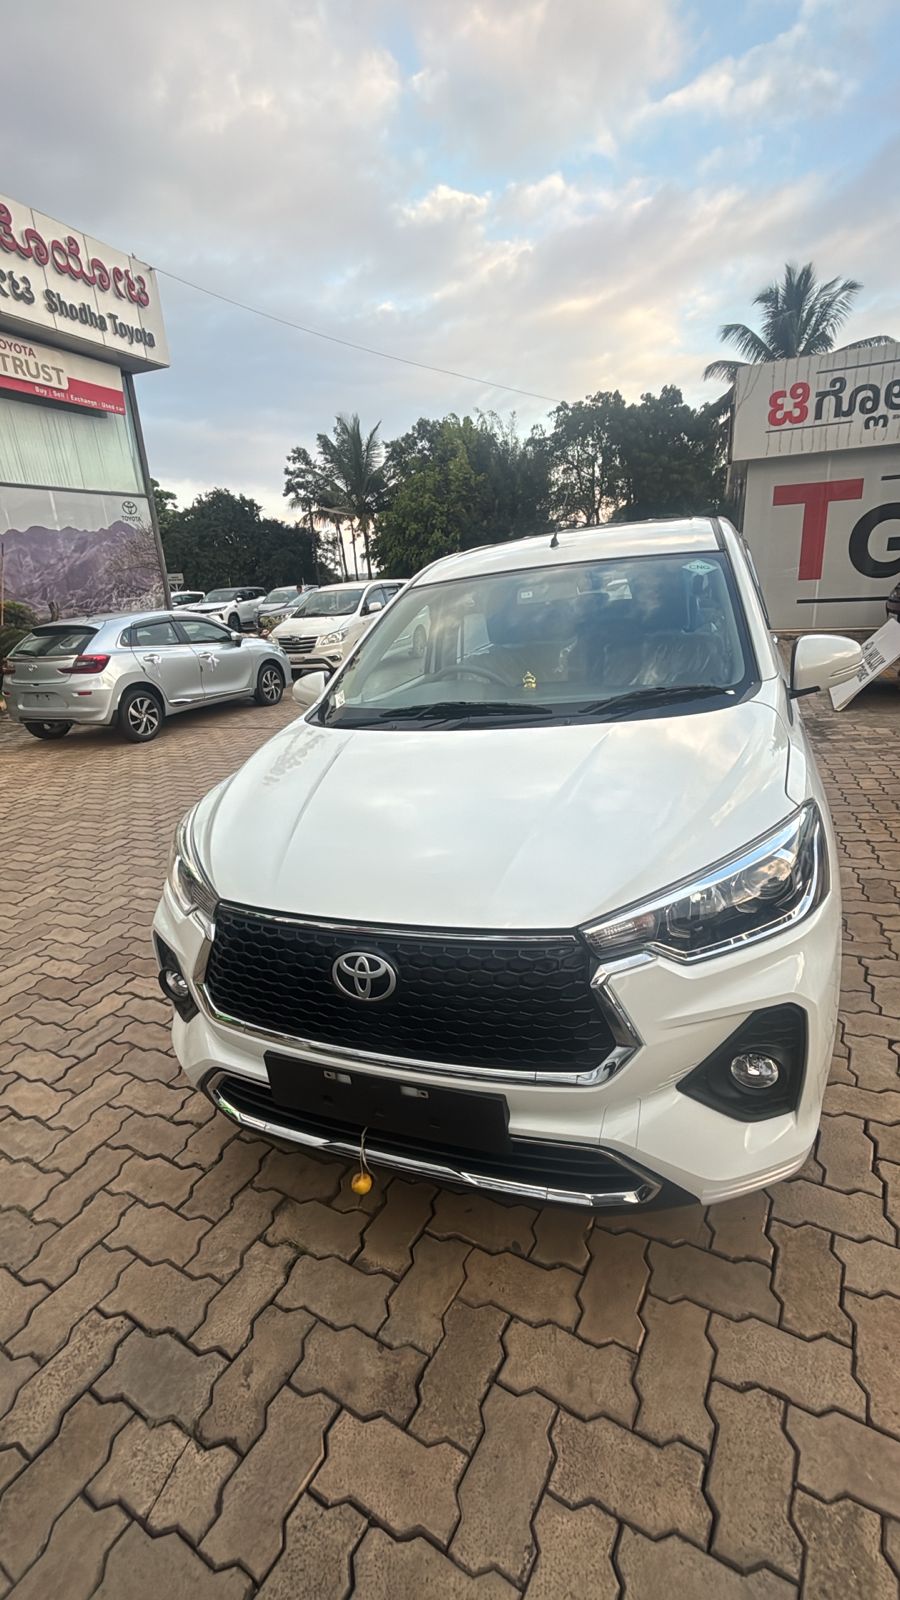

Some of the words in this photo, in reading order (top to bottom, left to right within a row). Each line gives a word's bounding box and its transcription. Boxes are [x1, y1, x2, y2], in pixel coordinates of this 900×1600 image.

[44, 288, 108, 332] Shodha
[107, 312, 156, 348] Toyota
[0, 353, 64, 386] TRUST
[34, 386, 48, 396] Buy
[53, 390, 65, 399] Sell
[121, 515, 143, 524] TOYOTA
